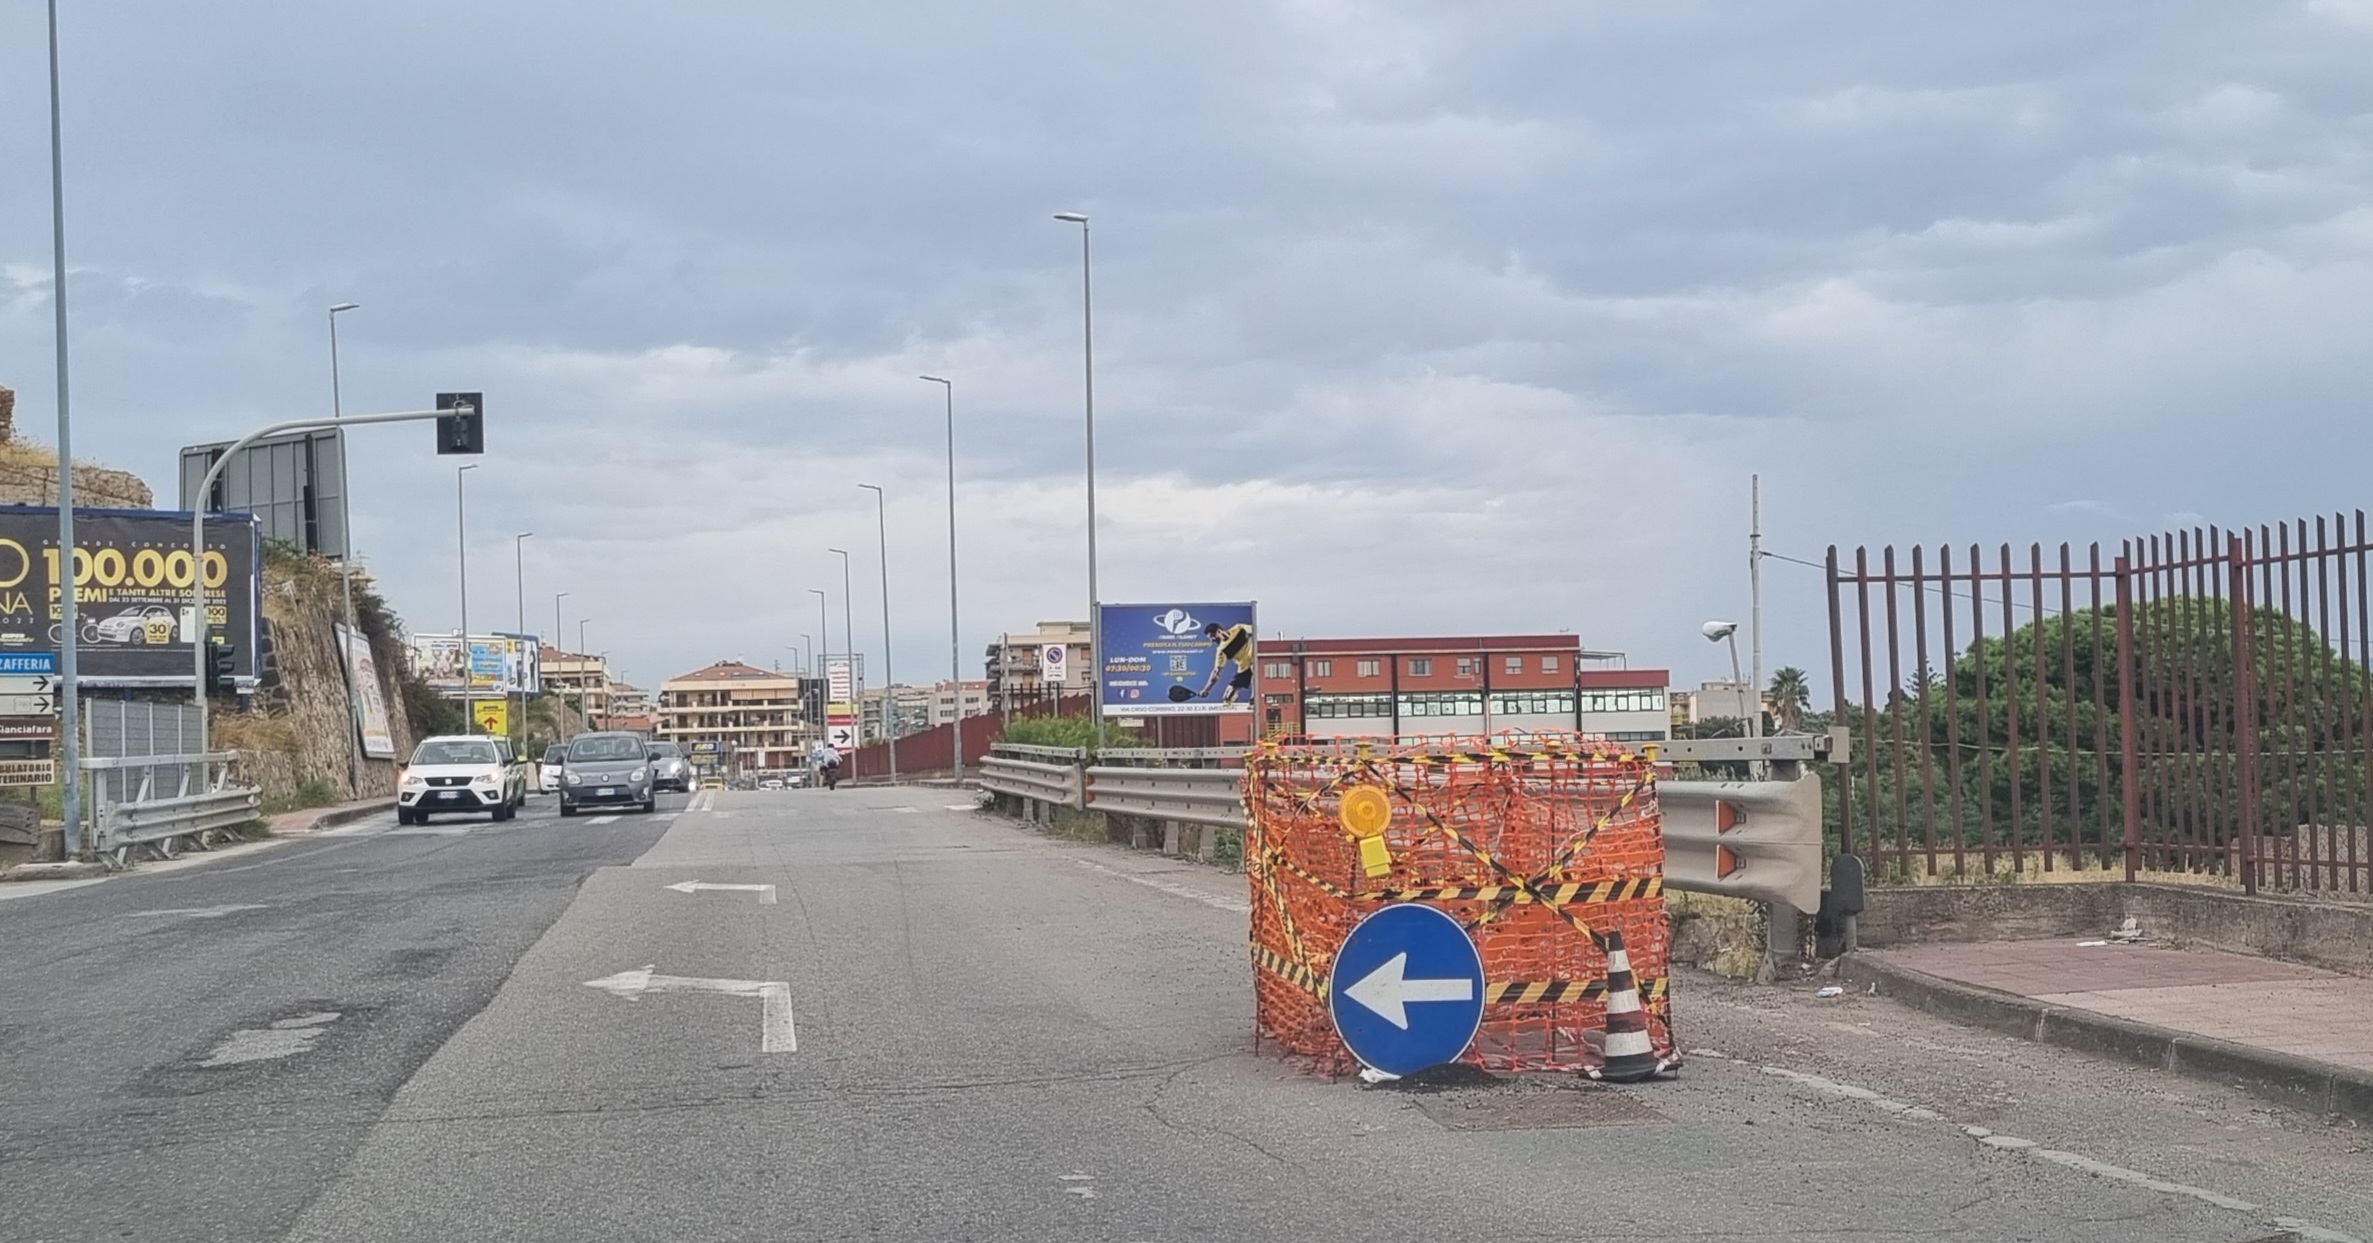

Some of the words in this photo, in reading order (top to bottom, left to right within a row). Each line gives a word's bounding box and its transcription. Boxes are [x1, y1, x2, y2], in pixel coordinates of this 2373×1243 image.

[42, 539, 113, 547] GNDE
[131, 541, 226, 550] CONCOSO
[43, 547, 228, 589] 100.000
[49, 587, 107, 603] PEMI
[116, 588, 146, 596] TANTE
[149, 589, 176, 597] ALTRE
[179, 589, 226, 598] SORESE
[207, 607, 225, 616] 100
[149, 623, 166, 634] 30
